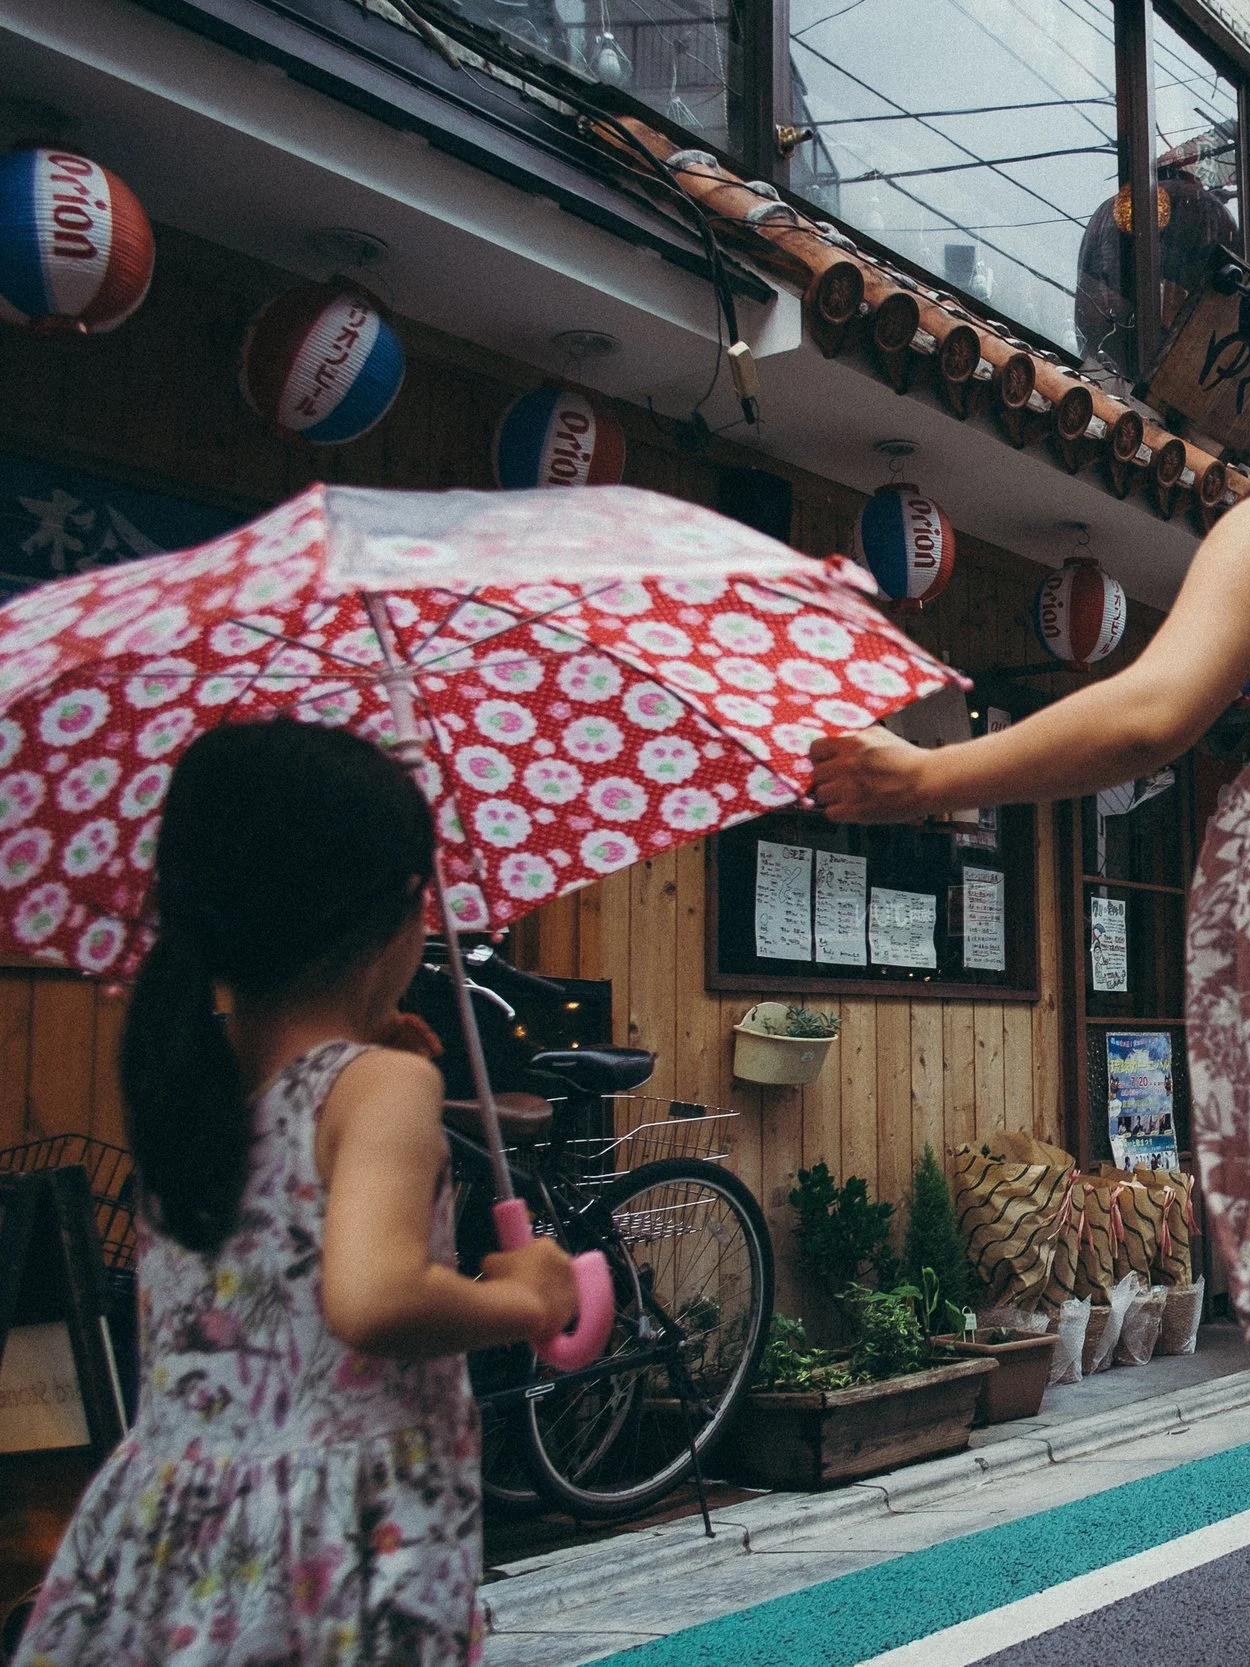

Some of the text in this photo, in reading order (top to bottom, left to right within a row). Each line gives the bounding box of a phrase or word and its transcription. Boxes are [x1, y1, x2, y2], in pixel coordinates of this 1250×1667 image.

[48, 155, 106, 259] Orion
[908, 500, 940, 569] Orion
[1042, 576, 1064, 639] Orion
[1098, 579, 1122, 656] リオンビール
